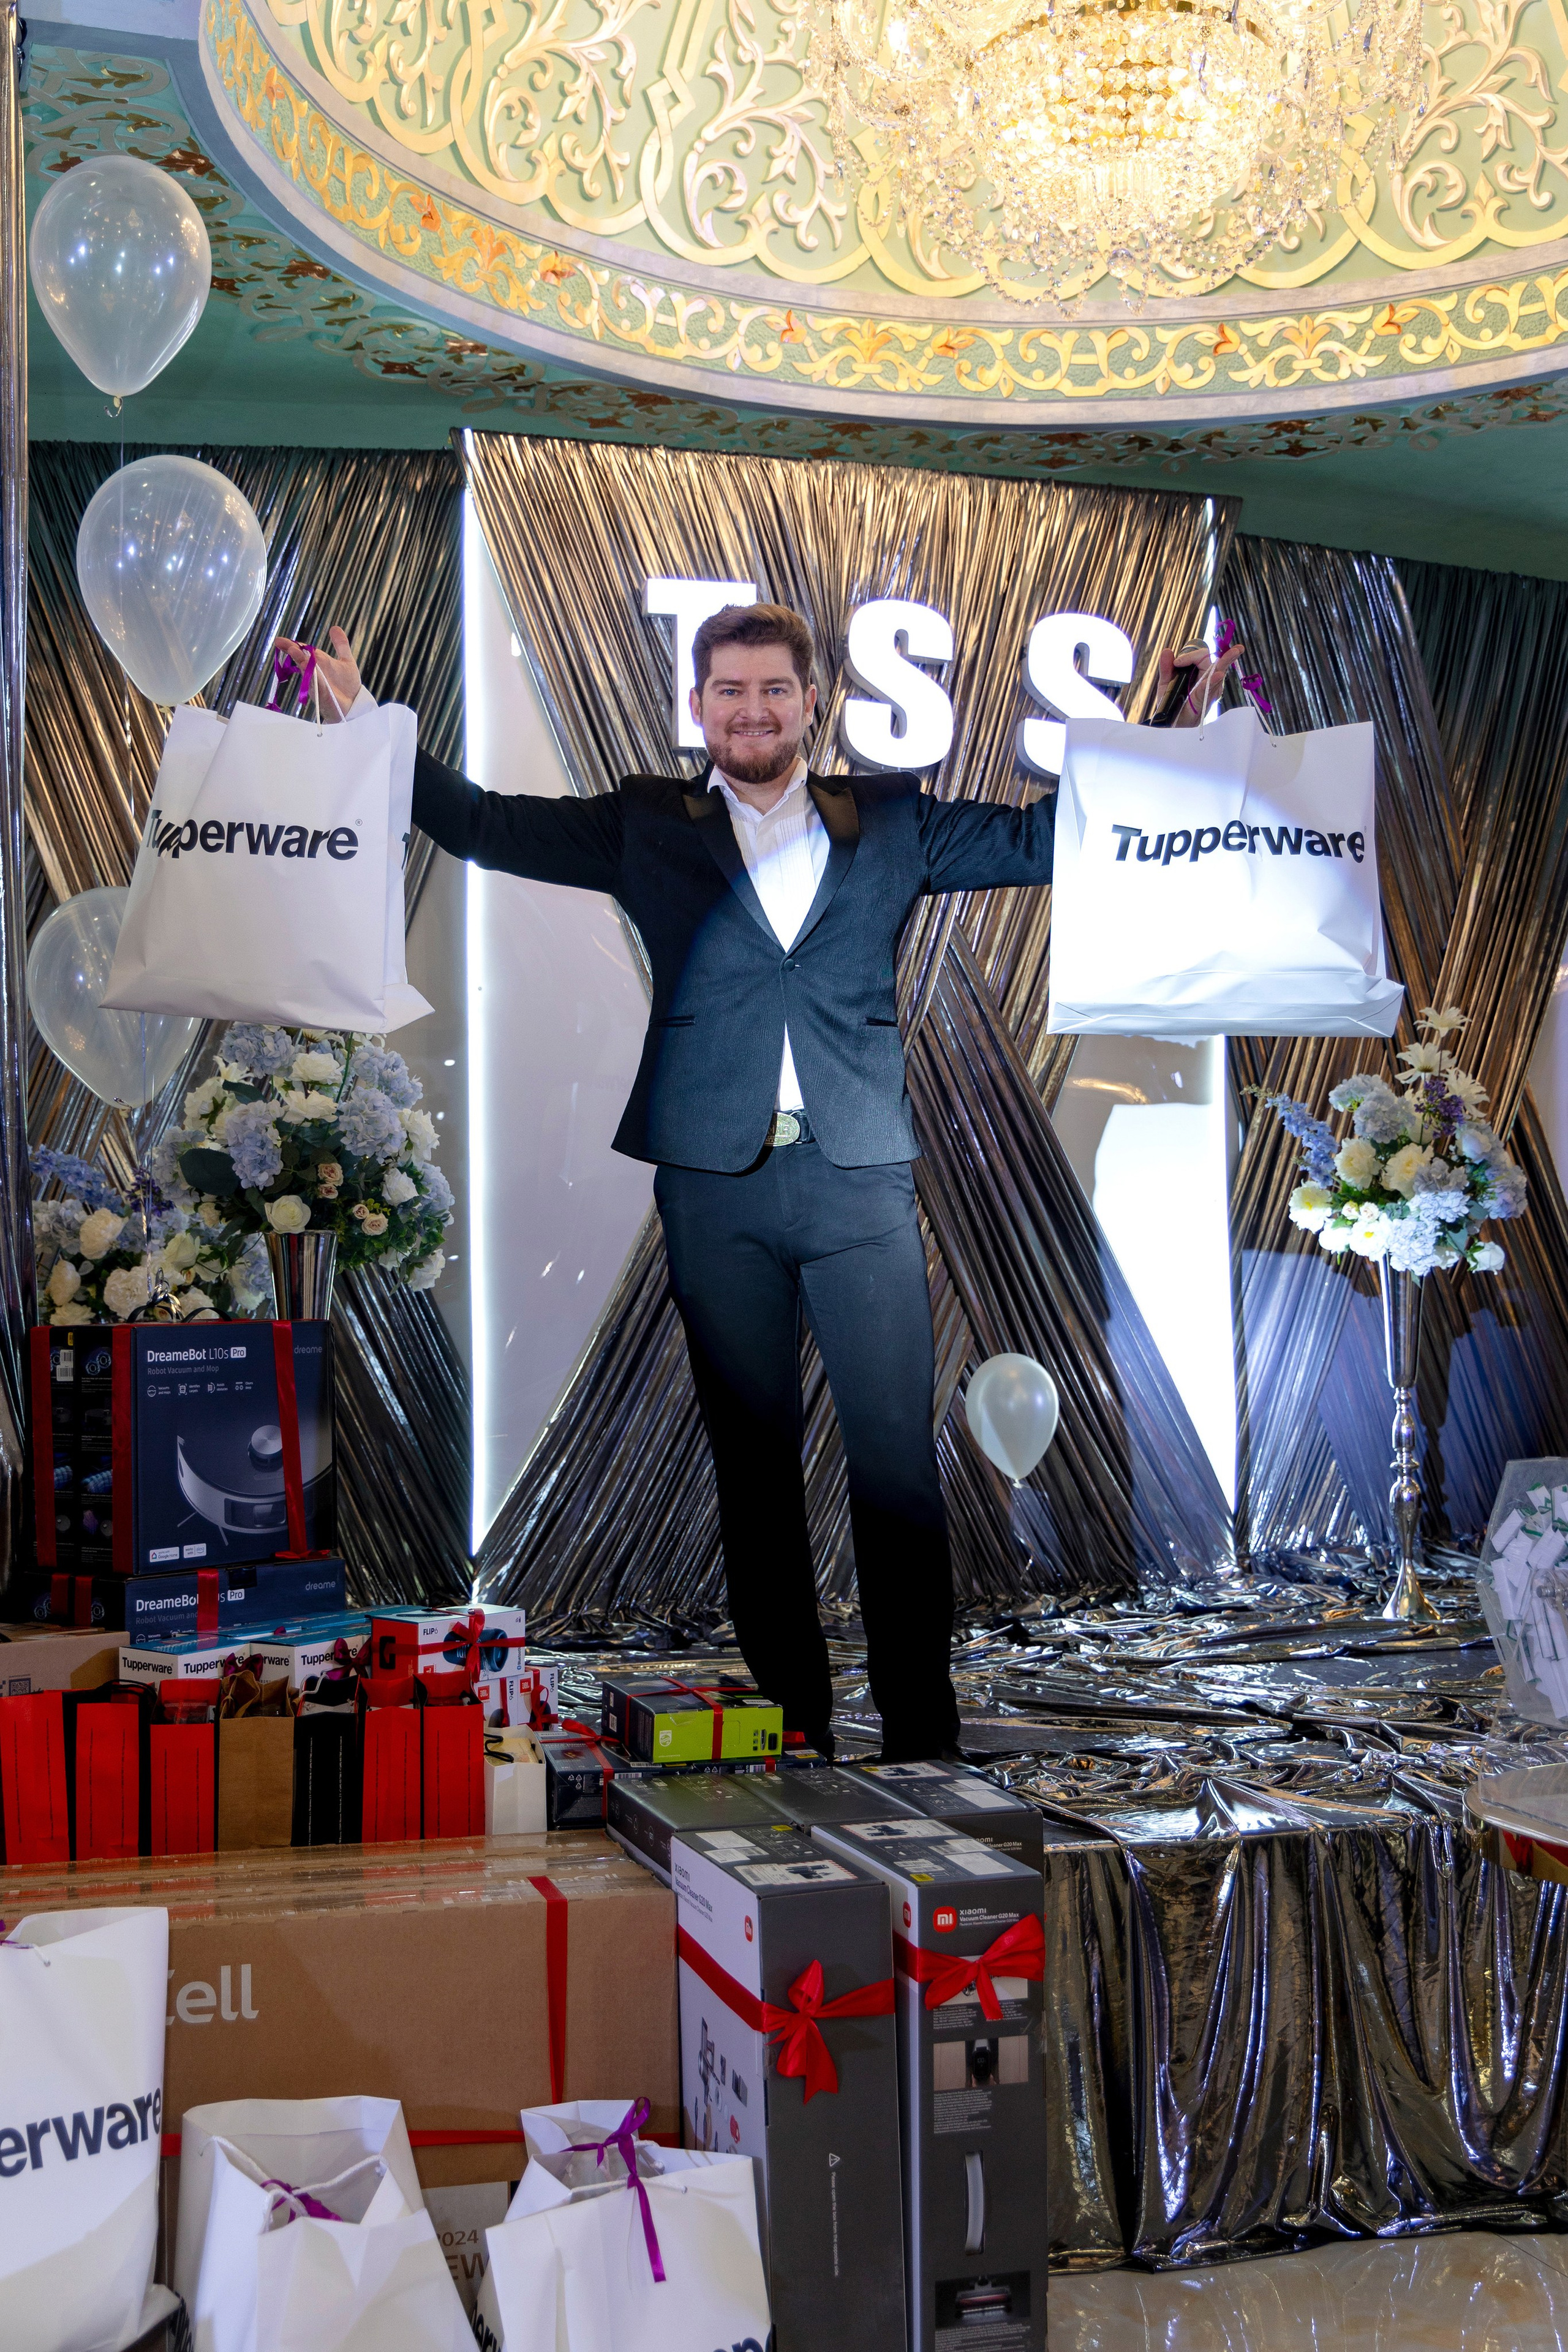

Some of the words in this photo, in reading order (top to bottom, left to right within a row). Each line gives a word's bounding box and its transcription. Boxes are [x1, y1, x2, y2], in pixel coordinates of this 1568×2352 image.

[146, 809, 360, 861] Tupperware
[1112, 819, 1365, 866] Tupperware
[147, 1348, 206, 1362] DreameBot
[209, 1348, 229, 1360] L10s
[232, 1348, 244, 1357] Pro
[294, 1345, 322, 1354] dreame
[206, 1365, 219, 1373] Mop
[306, 1581, 336, 1591] dreame
[136, 1616, 156, 1624] Robot
[157, 1614, 184, 1623] Vacuum
[423, 1627, 439, 1636] FLIP6
[301, 1647, 358, 1666] Tupperre
[122, 1657, 173, 1675] Tupperware
[184, 1654, 244, 1674] Tupperwre
[507, 1874, 621, 1886] NnoCell
[165, 1964, 259, 2024] ell
